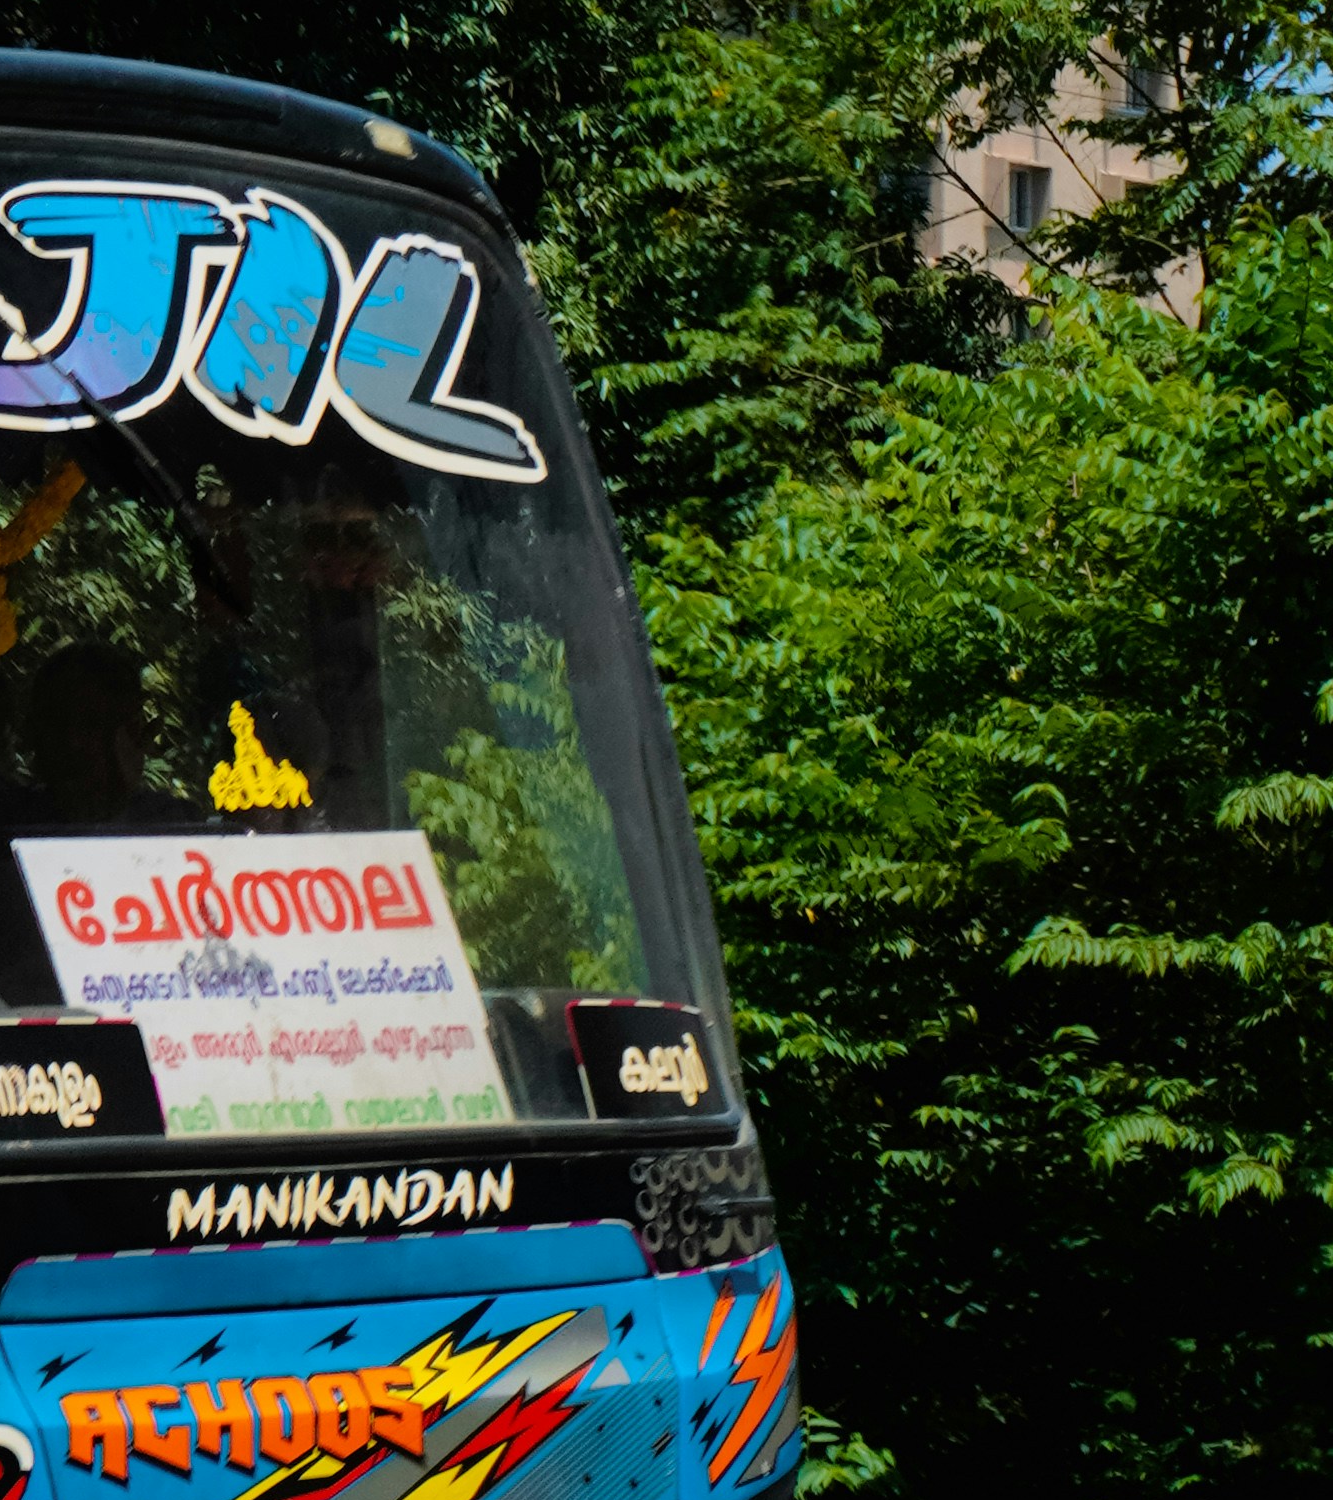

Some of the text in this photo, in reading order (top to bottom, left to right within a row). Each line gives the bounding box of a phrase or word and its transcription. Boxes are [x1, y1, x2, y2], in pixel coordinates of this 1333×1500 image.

[55, 849, 434, 947] ചേർത്തല
[167, 1160, 515, 1242] MANIKANDAN
[59, 1364, 424, 1482] ACHOOS
